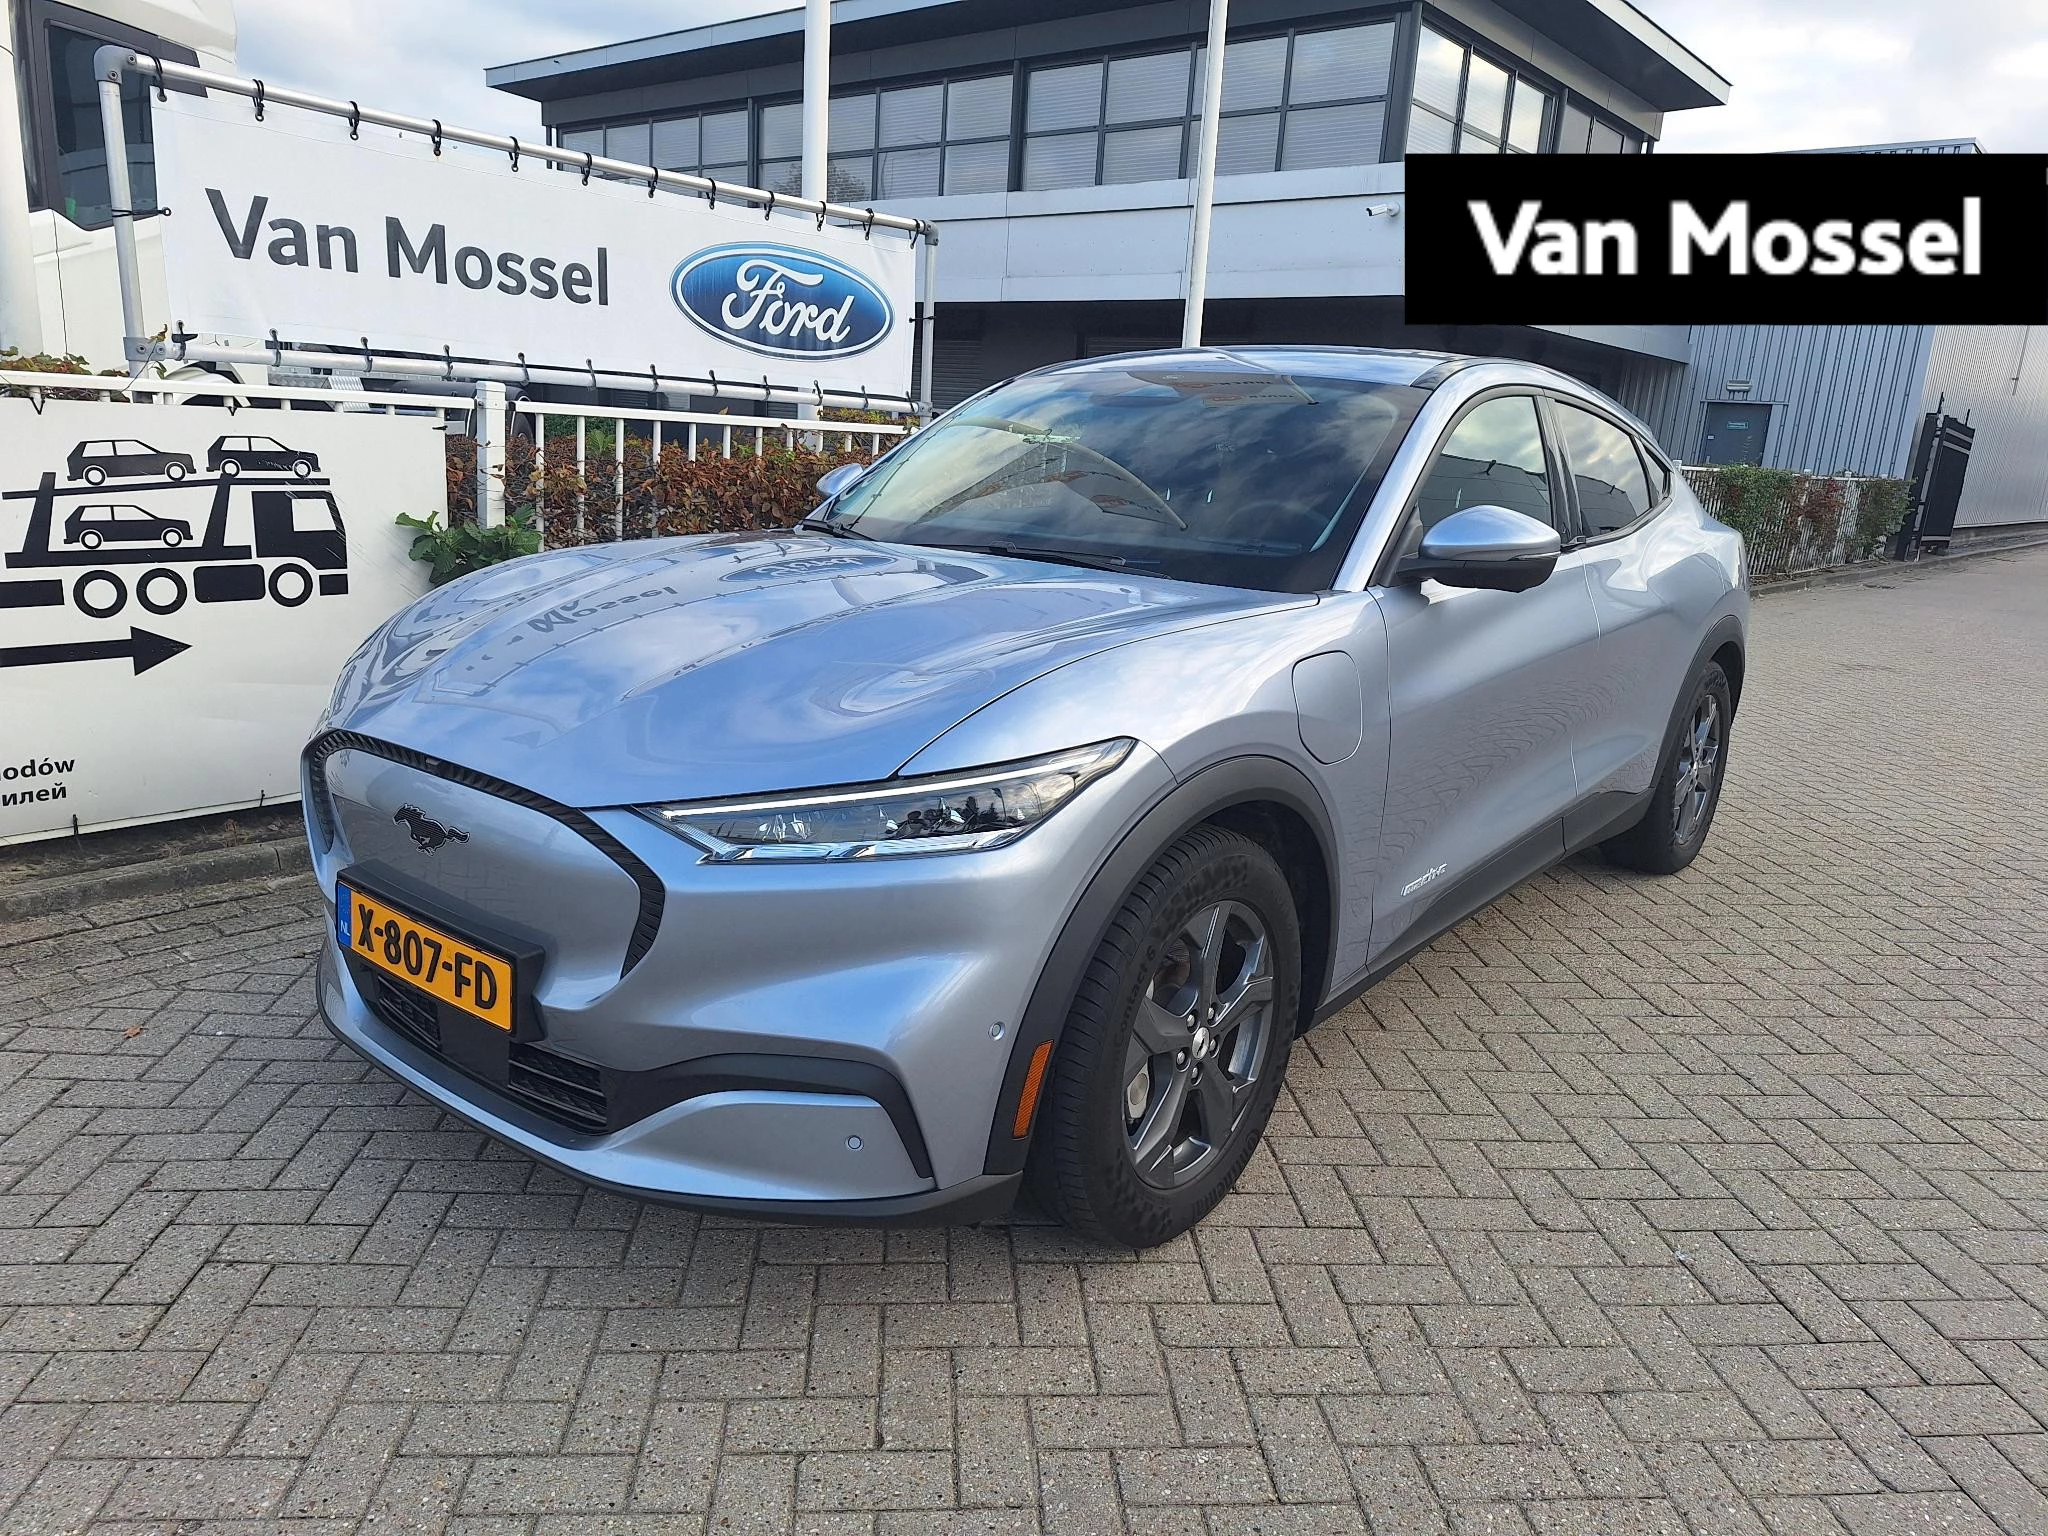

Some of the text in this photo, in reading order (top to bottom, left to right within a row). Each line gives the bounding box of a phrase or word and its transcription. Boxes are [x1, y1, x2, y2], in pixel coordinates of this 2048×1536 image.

[205, 188, 609, 307] Van Mossel
[719, 257, 855, 344] Ford
[0, 757, 75, 780] odów
[1, 782, 67, 807] илей
[340, 919, 351, 937] NL
[358, 903, 498, 1011] X-807-FD
